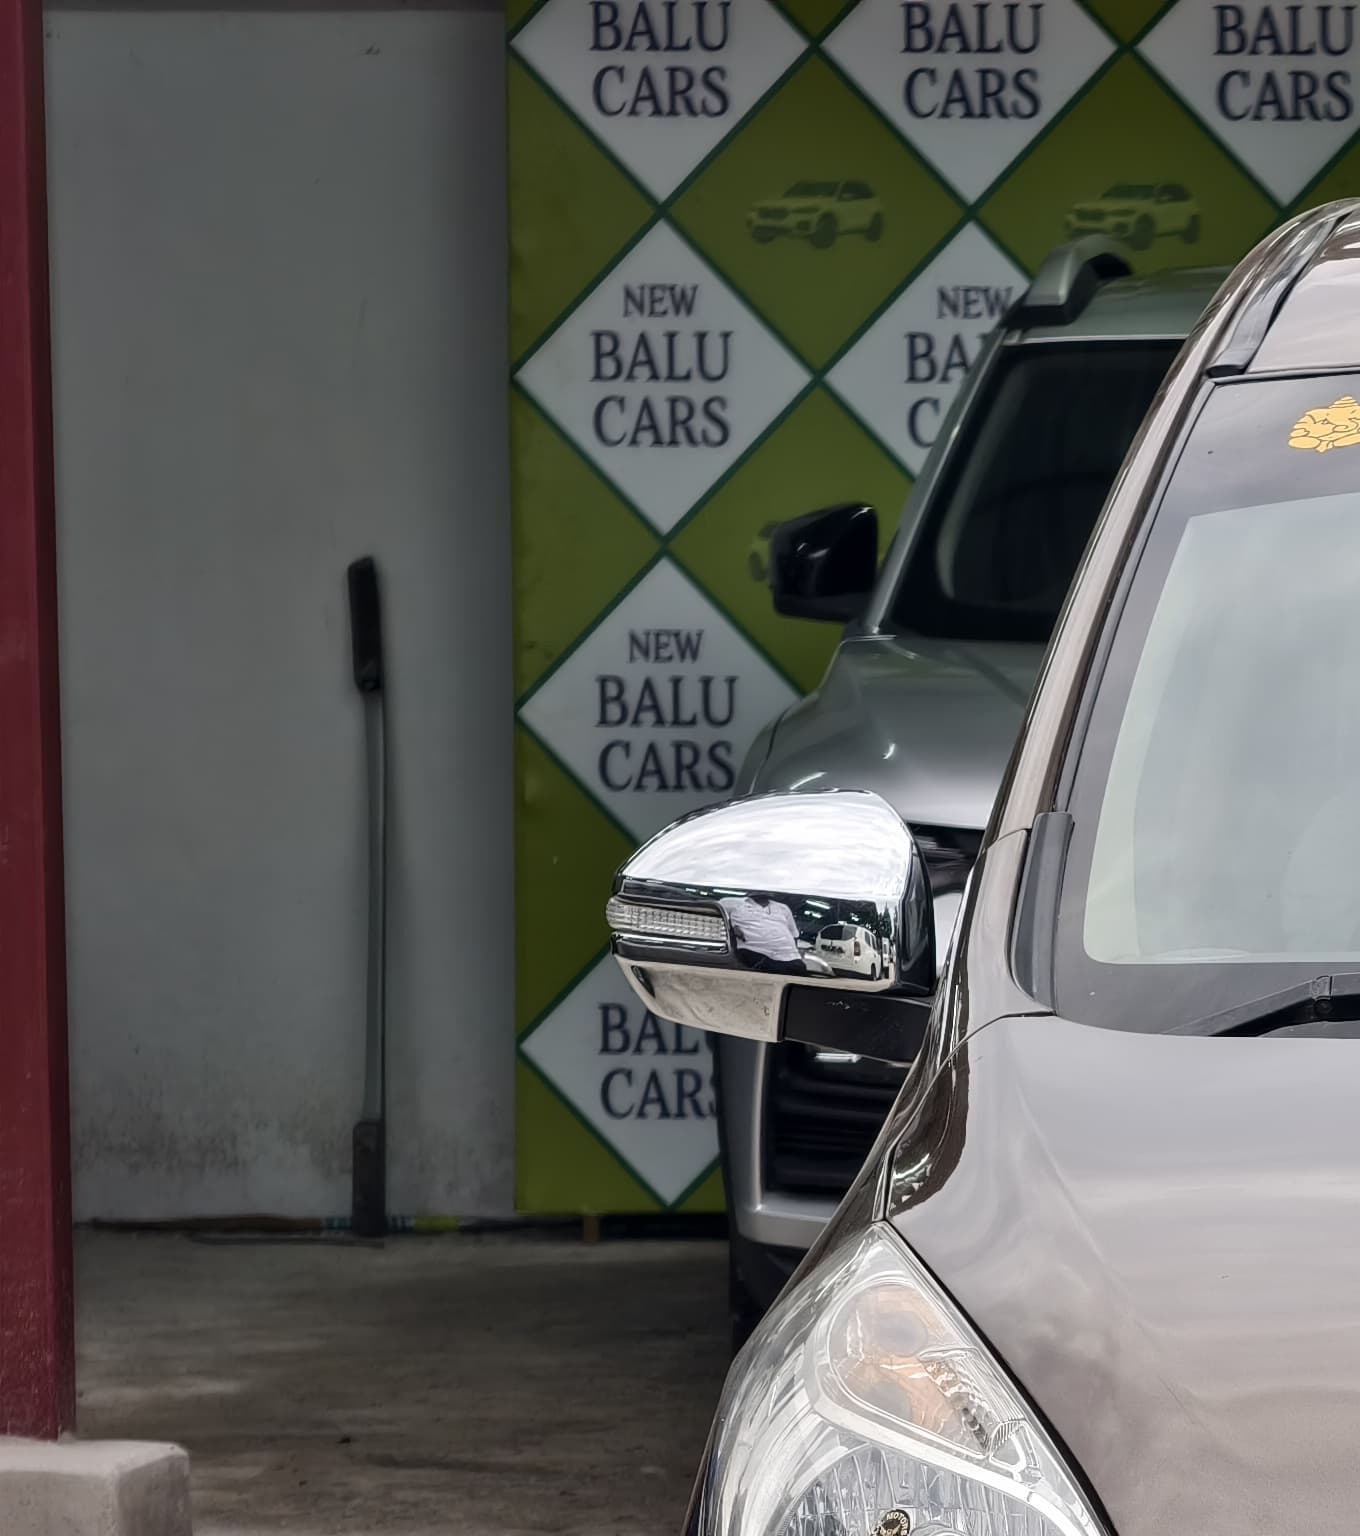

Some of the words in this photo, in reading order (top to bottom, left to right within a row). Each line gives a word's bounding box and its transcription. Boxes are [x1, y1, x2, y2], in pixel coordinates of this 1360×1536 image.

[590, 0, 732, 53] BALU
[901, 2, 1045, 55] BALU
[1213, 4, 1356, 57] BALU
[592, 65, 730, 118] CARS
[904, 68, 1041, 119] CARS
[1217, 70, 1354, 121] CARS
[623, 284, 698, 318] NEW
[591, 330, 733, 383] BALU
[905, 331, 992, 384] BA
[593, 396, 731, 448] CARS
[629, 629, 703, 664] NEW
[596, 676, 739, 729] BALU
[599, 740, 736, 793] CARS
[598, 1002, 714, 1056] BAL
